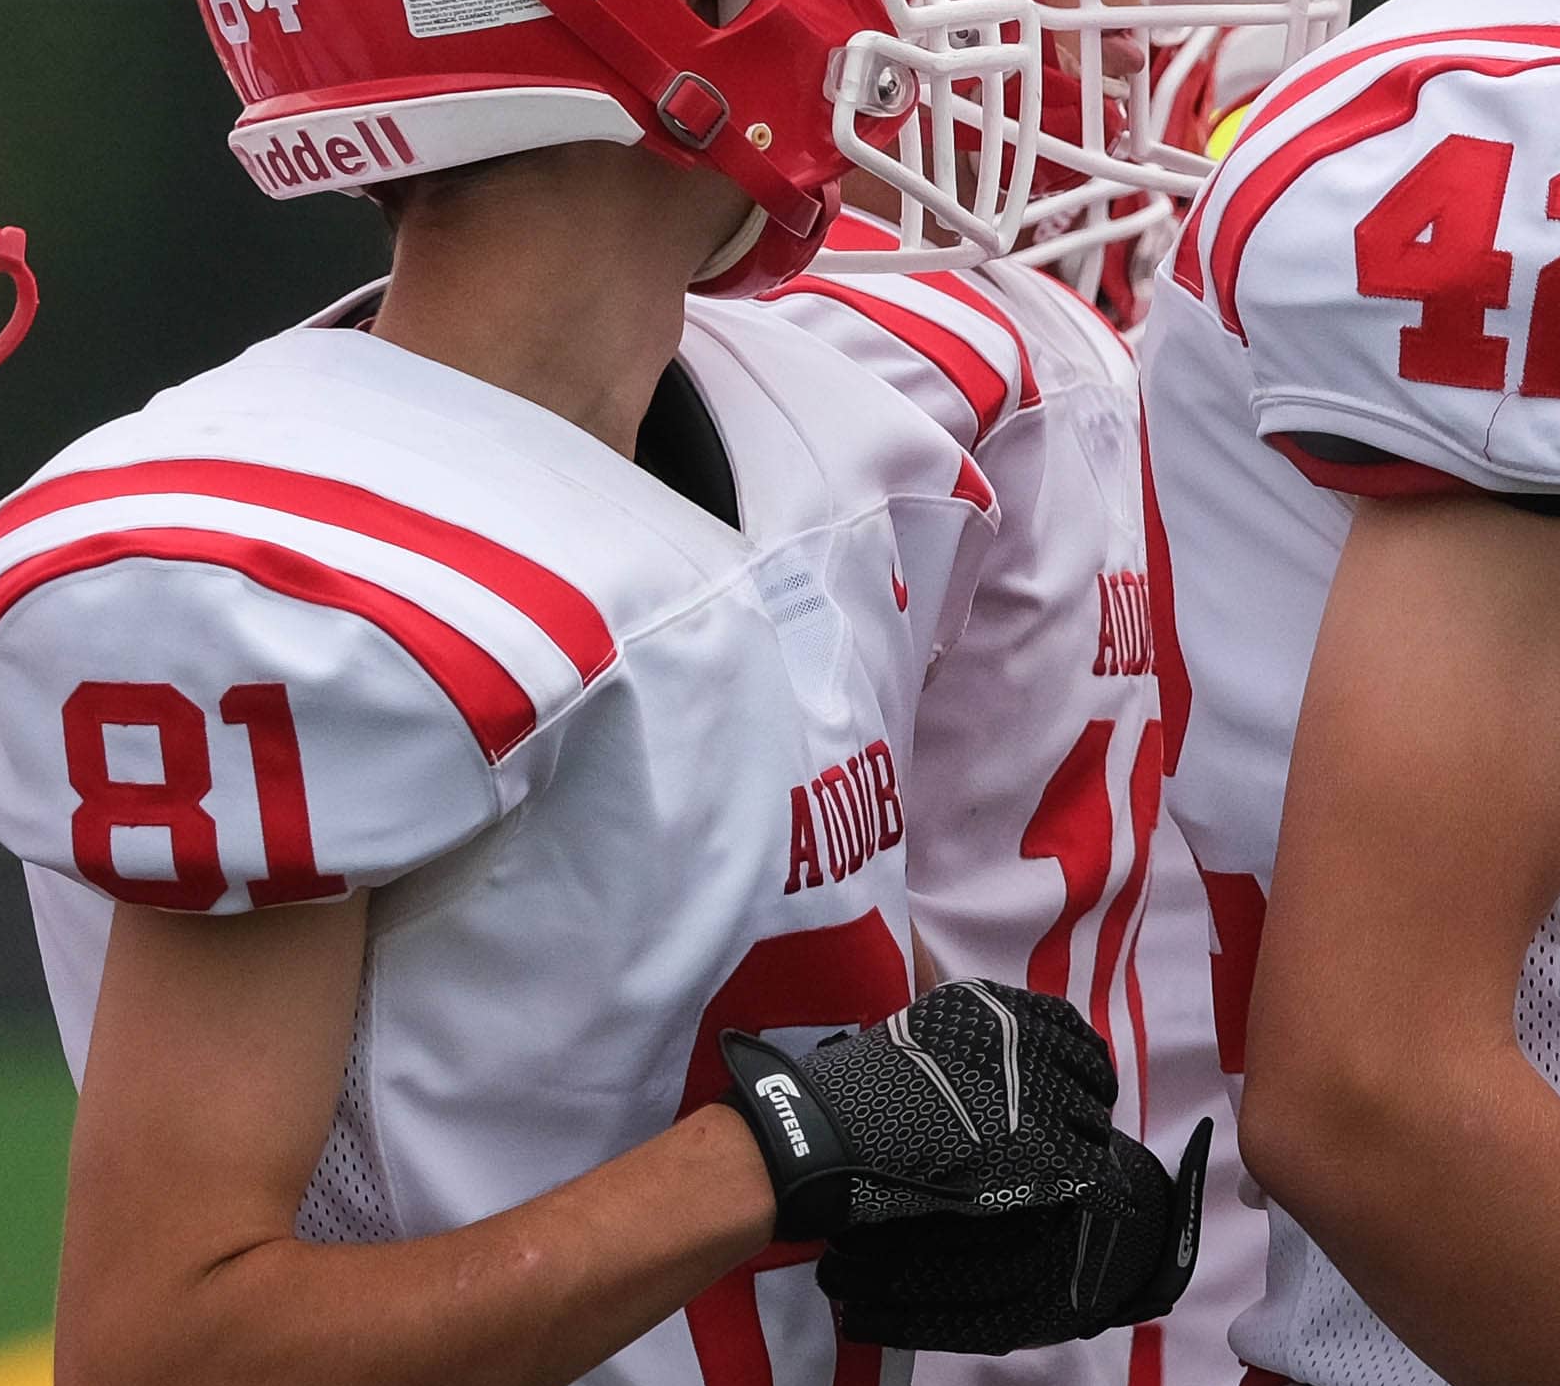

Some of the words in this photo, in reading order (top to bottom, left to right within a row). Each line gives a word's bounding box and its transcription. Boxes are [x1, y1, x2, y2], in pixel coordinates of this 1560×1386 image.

[61, 679, 348, 914] 81
[784, 738, 904, 895] AUDUB
[755, 1073, 810, 1157] CUTTERS
